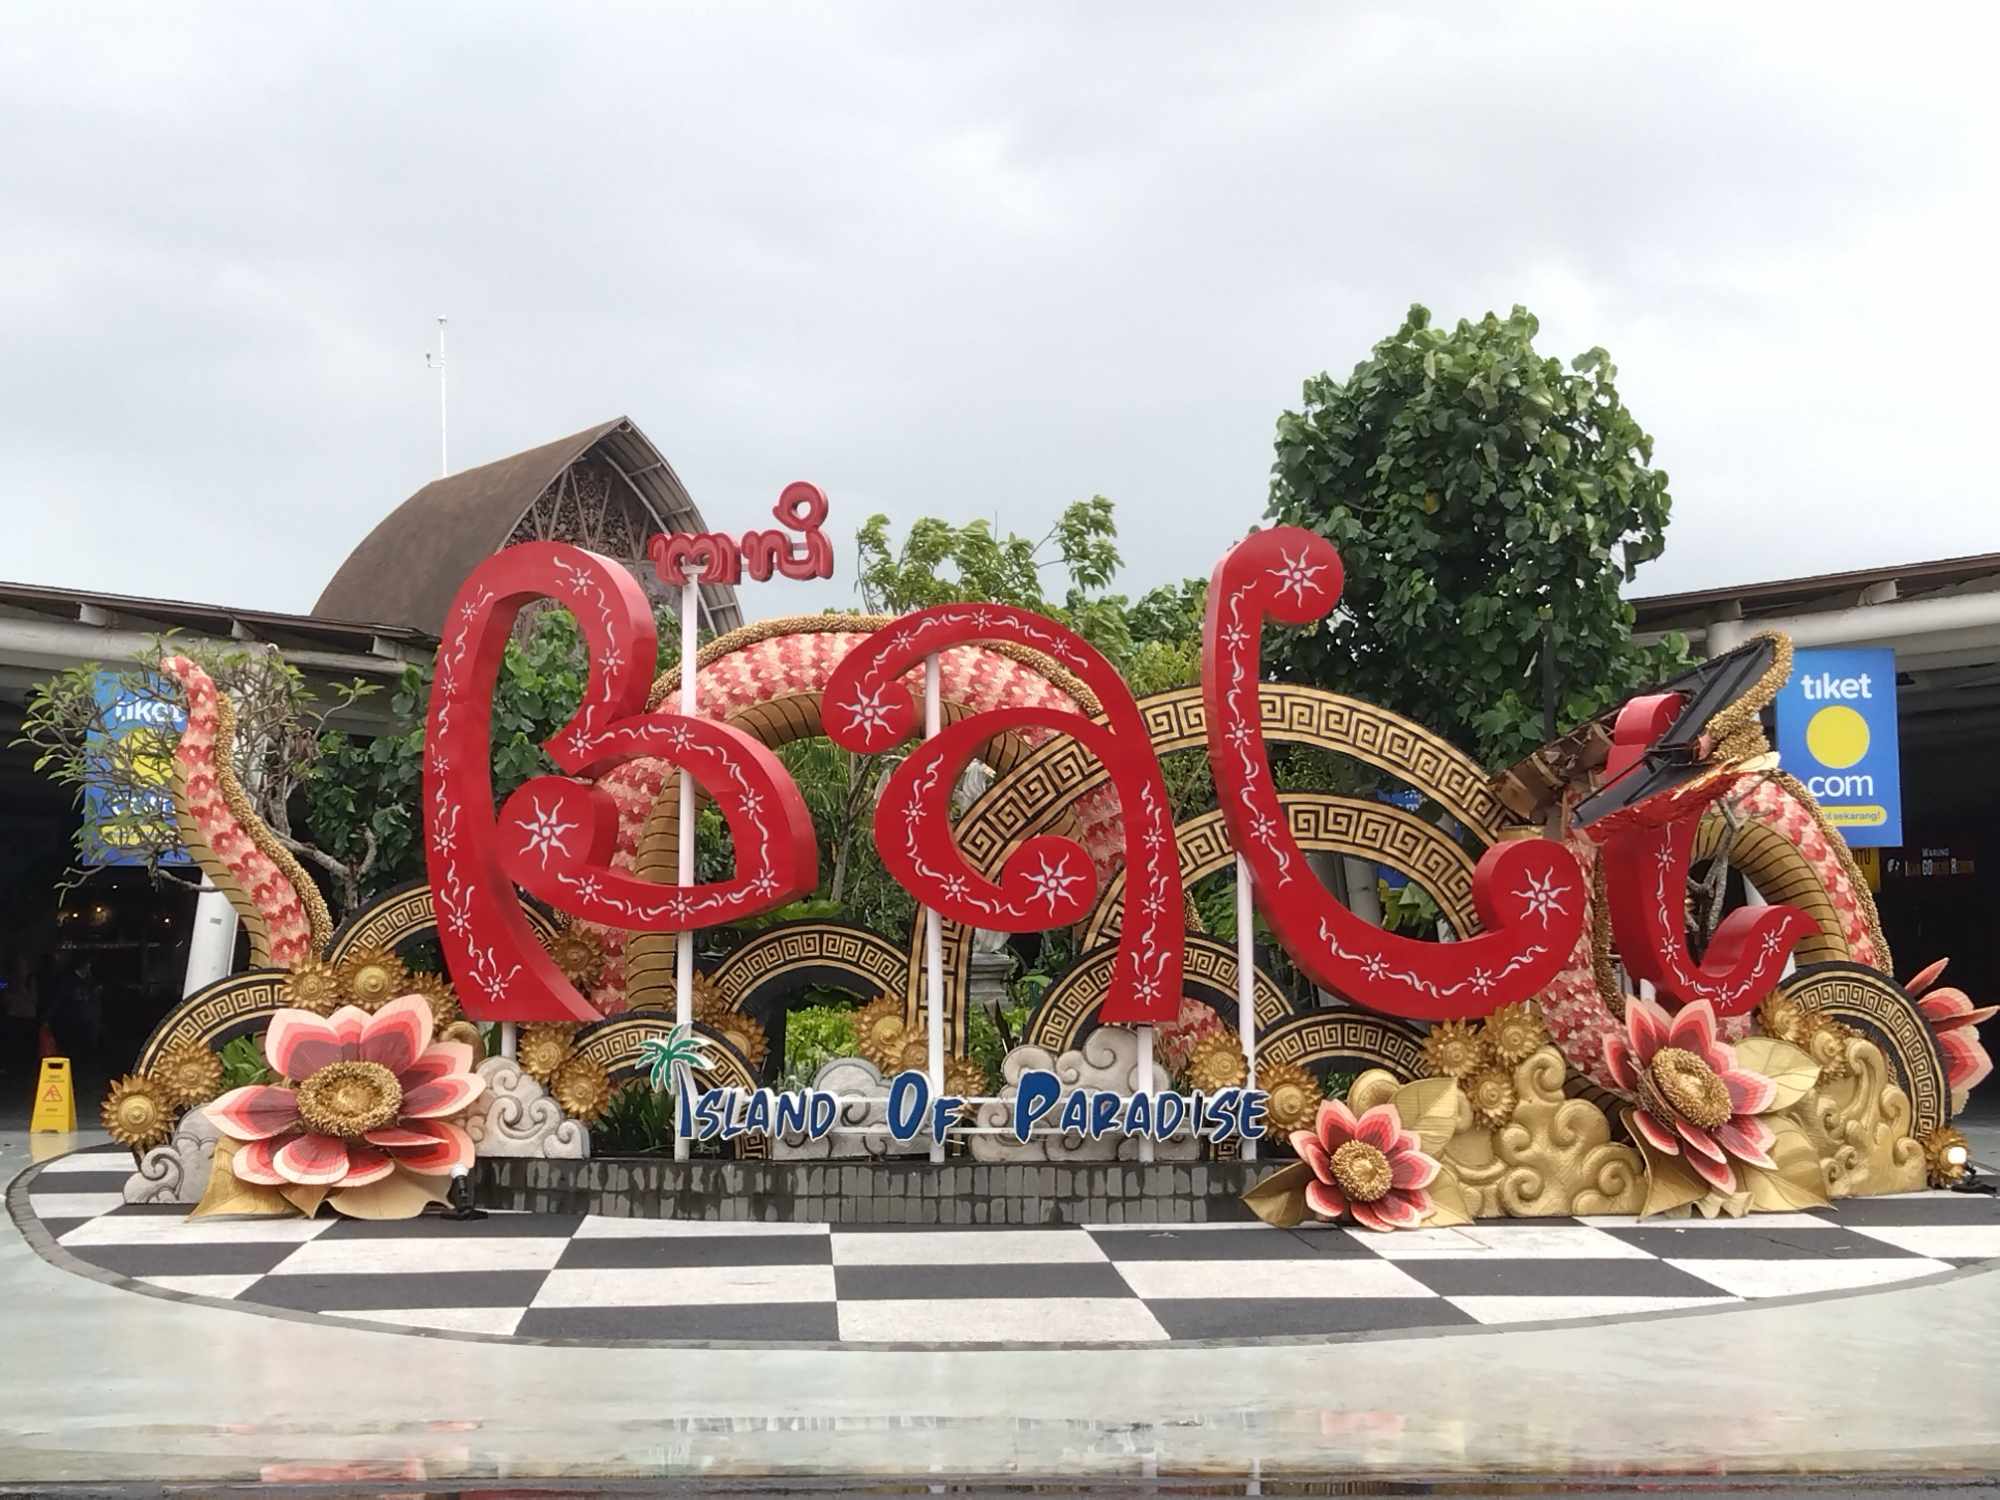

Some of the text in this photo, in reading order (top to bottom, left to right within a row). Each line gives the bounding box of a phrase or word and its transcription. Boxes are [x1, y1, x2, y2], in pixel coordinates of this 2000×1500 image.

[1800, 672, 1873, 700] tiket
[1808, 775, 1874, 797] com
[676, 1063, 840, 1141] ISLAND
[1013, 1069, 1272, 1144] PARADISE
